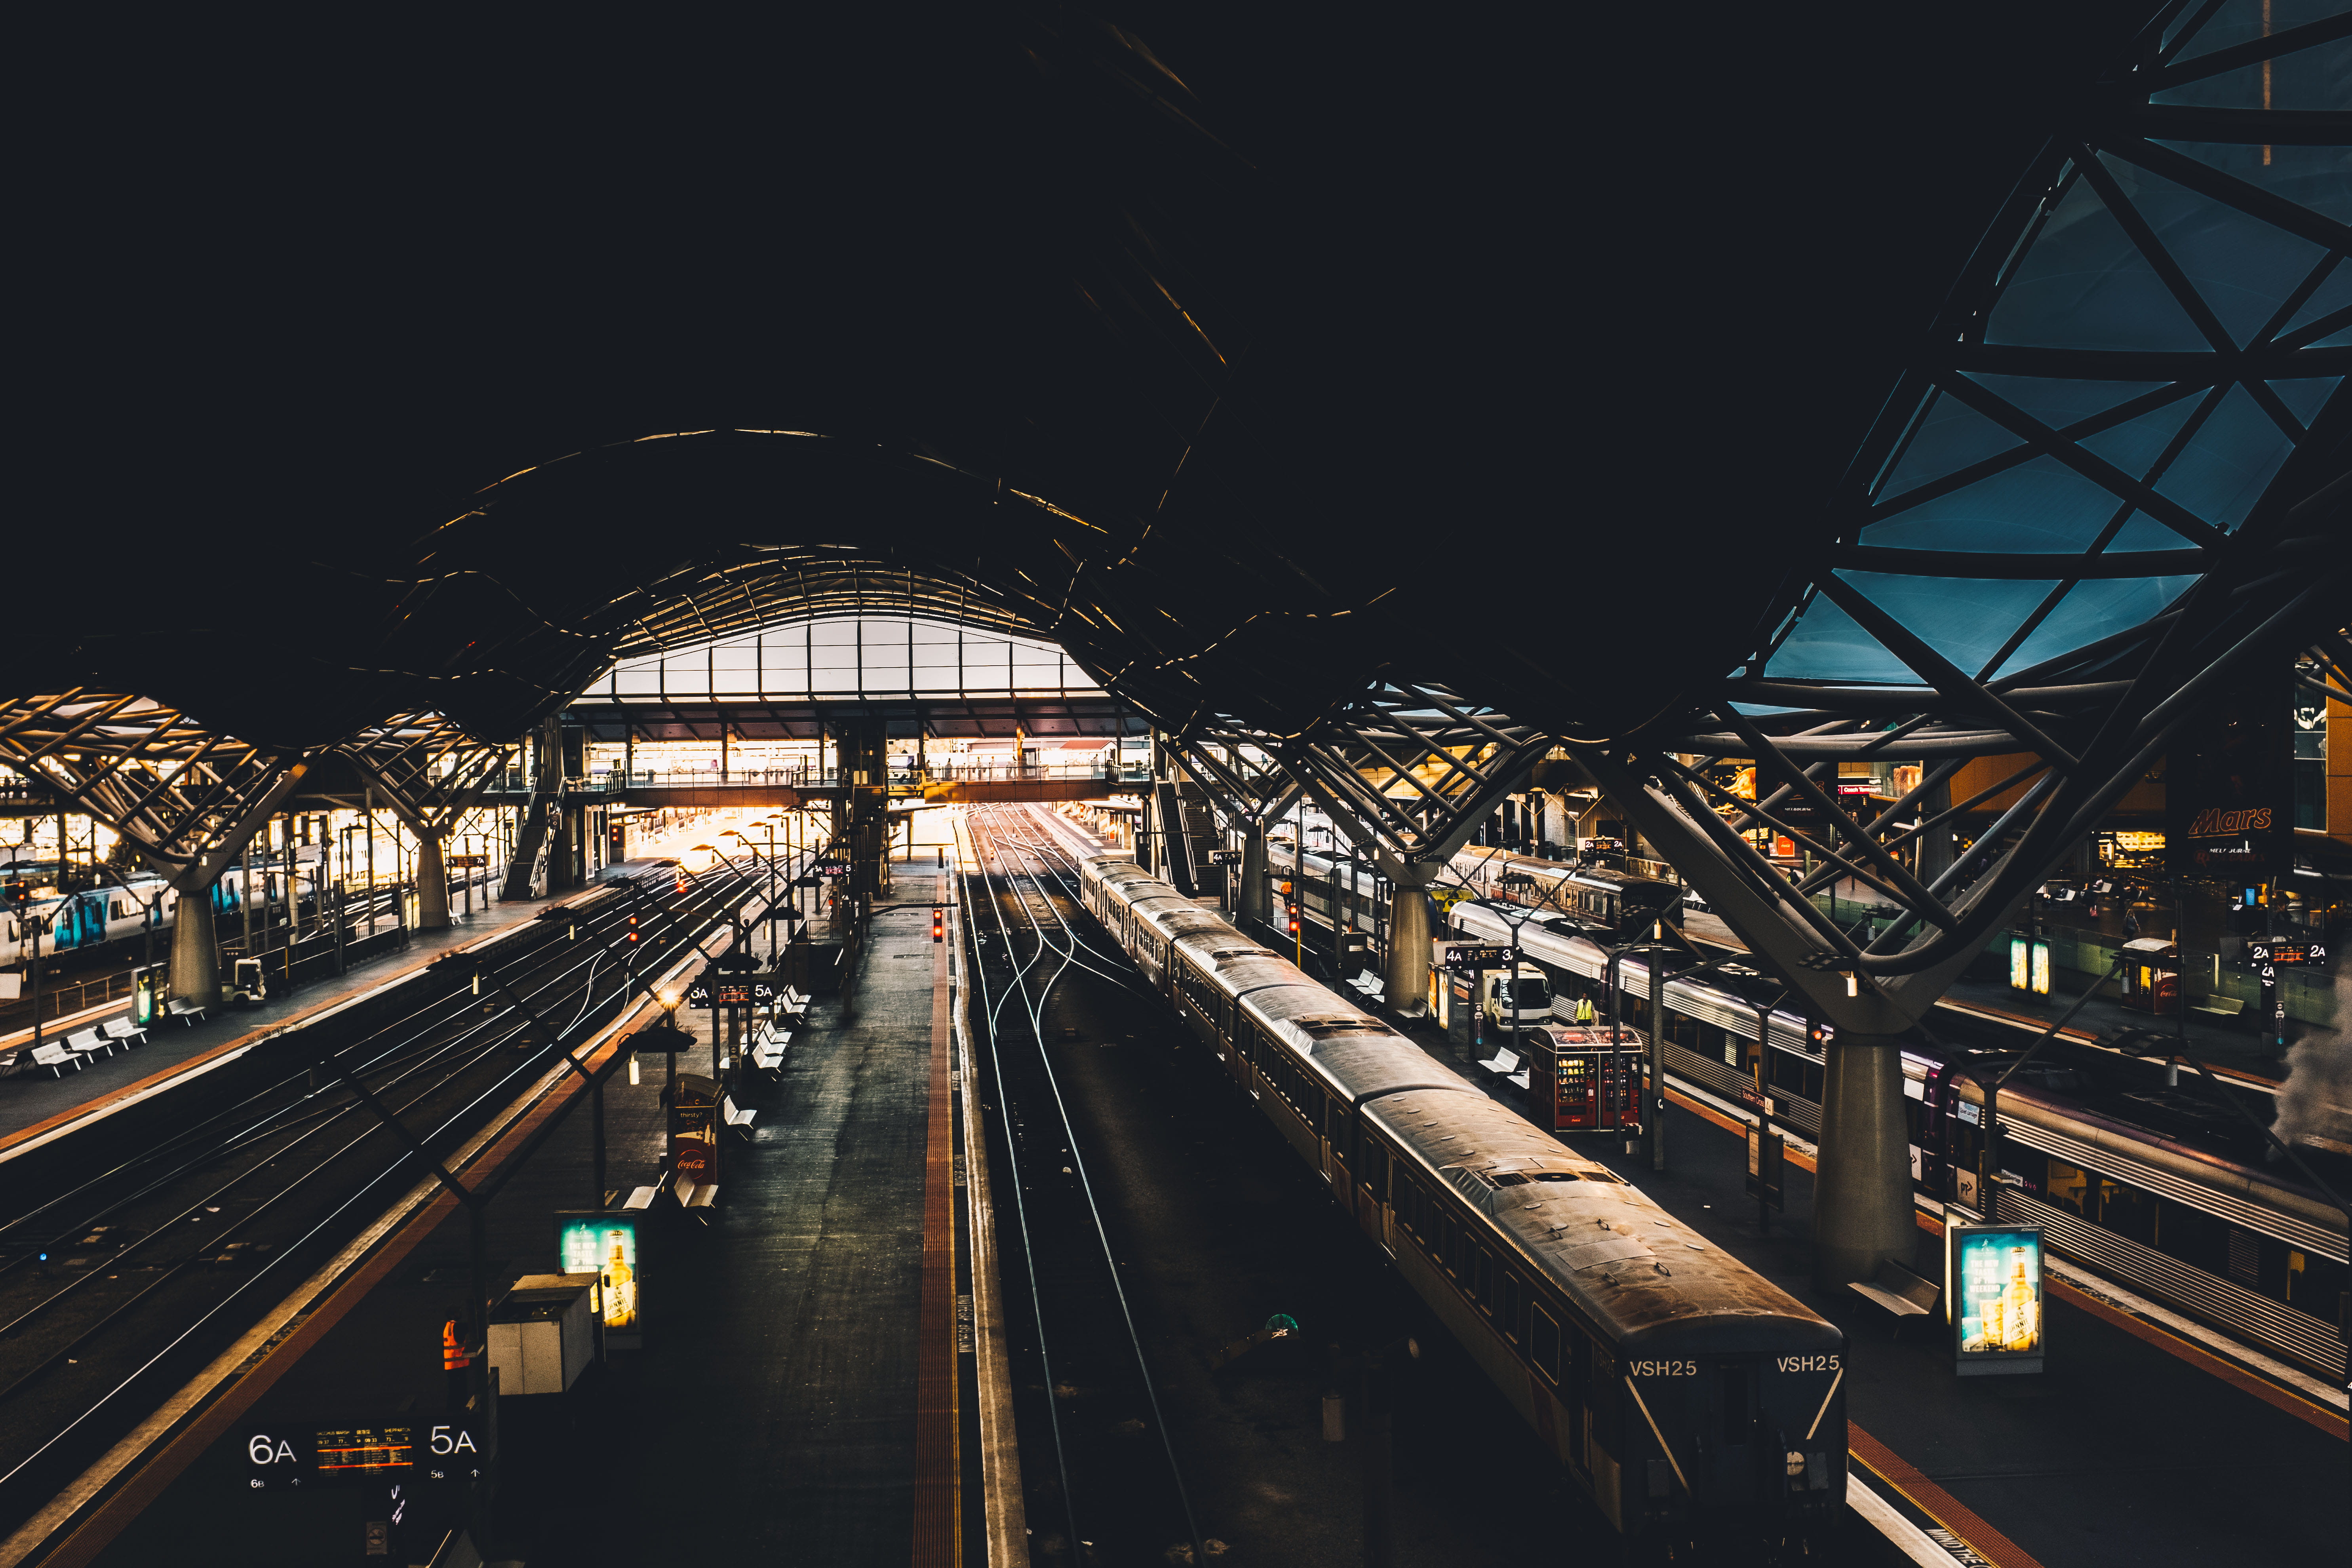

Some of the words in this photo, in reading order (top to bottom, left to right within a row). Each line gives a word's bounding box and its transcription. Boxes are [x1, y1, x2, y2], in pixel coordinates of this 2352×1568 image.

[2188, 808, 2272, 834] Mars
[1446, 950, 1462, 961] 4A
[2253, 947, 2269, 959] 2A
[2310, 945, 2325, 957] 2A
[755, 985, 772, 997] 5A
[677, 1160, 706, 1169] Coca-Cola
[1629, 1361, 1697, 1376] VSH25
[1777, 1355, 1840, 1372] VSH25
[430, 1425, 477, 1454] 5A
[250, 1435, 297, 1464] 6A
[431, 1470, 444, 1478] 5B
[251, 1479, 264, 1488] 6B
[1924, 1529, 1964, 1548] MIND
[1950, 1548, 1985, 1564] THE
